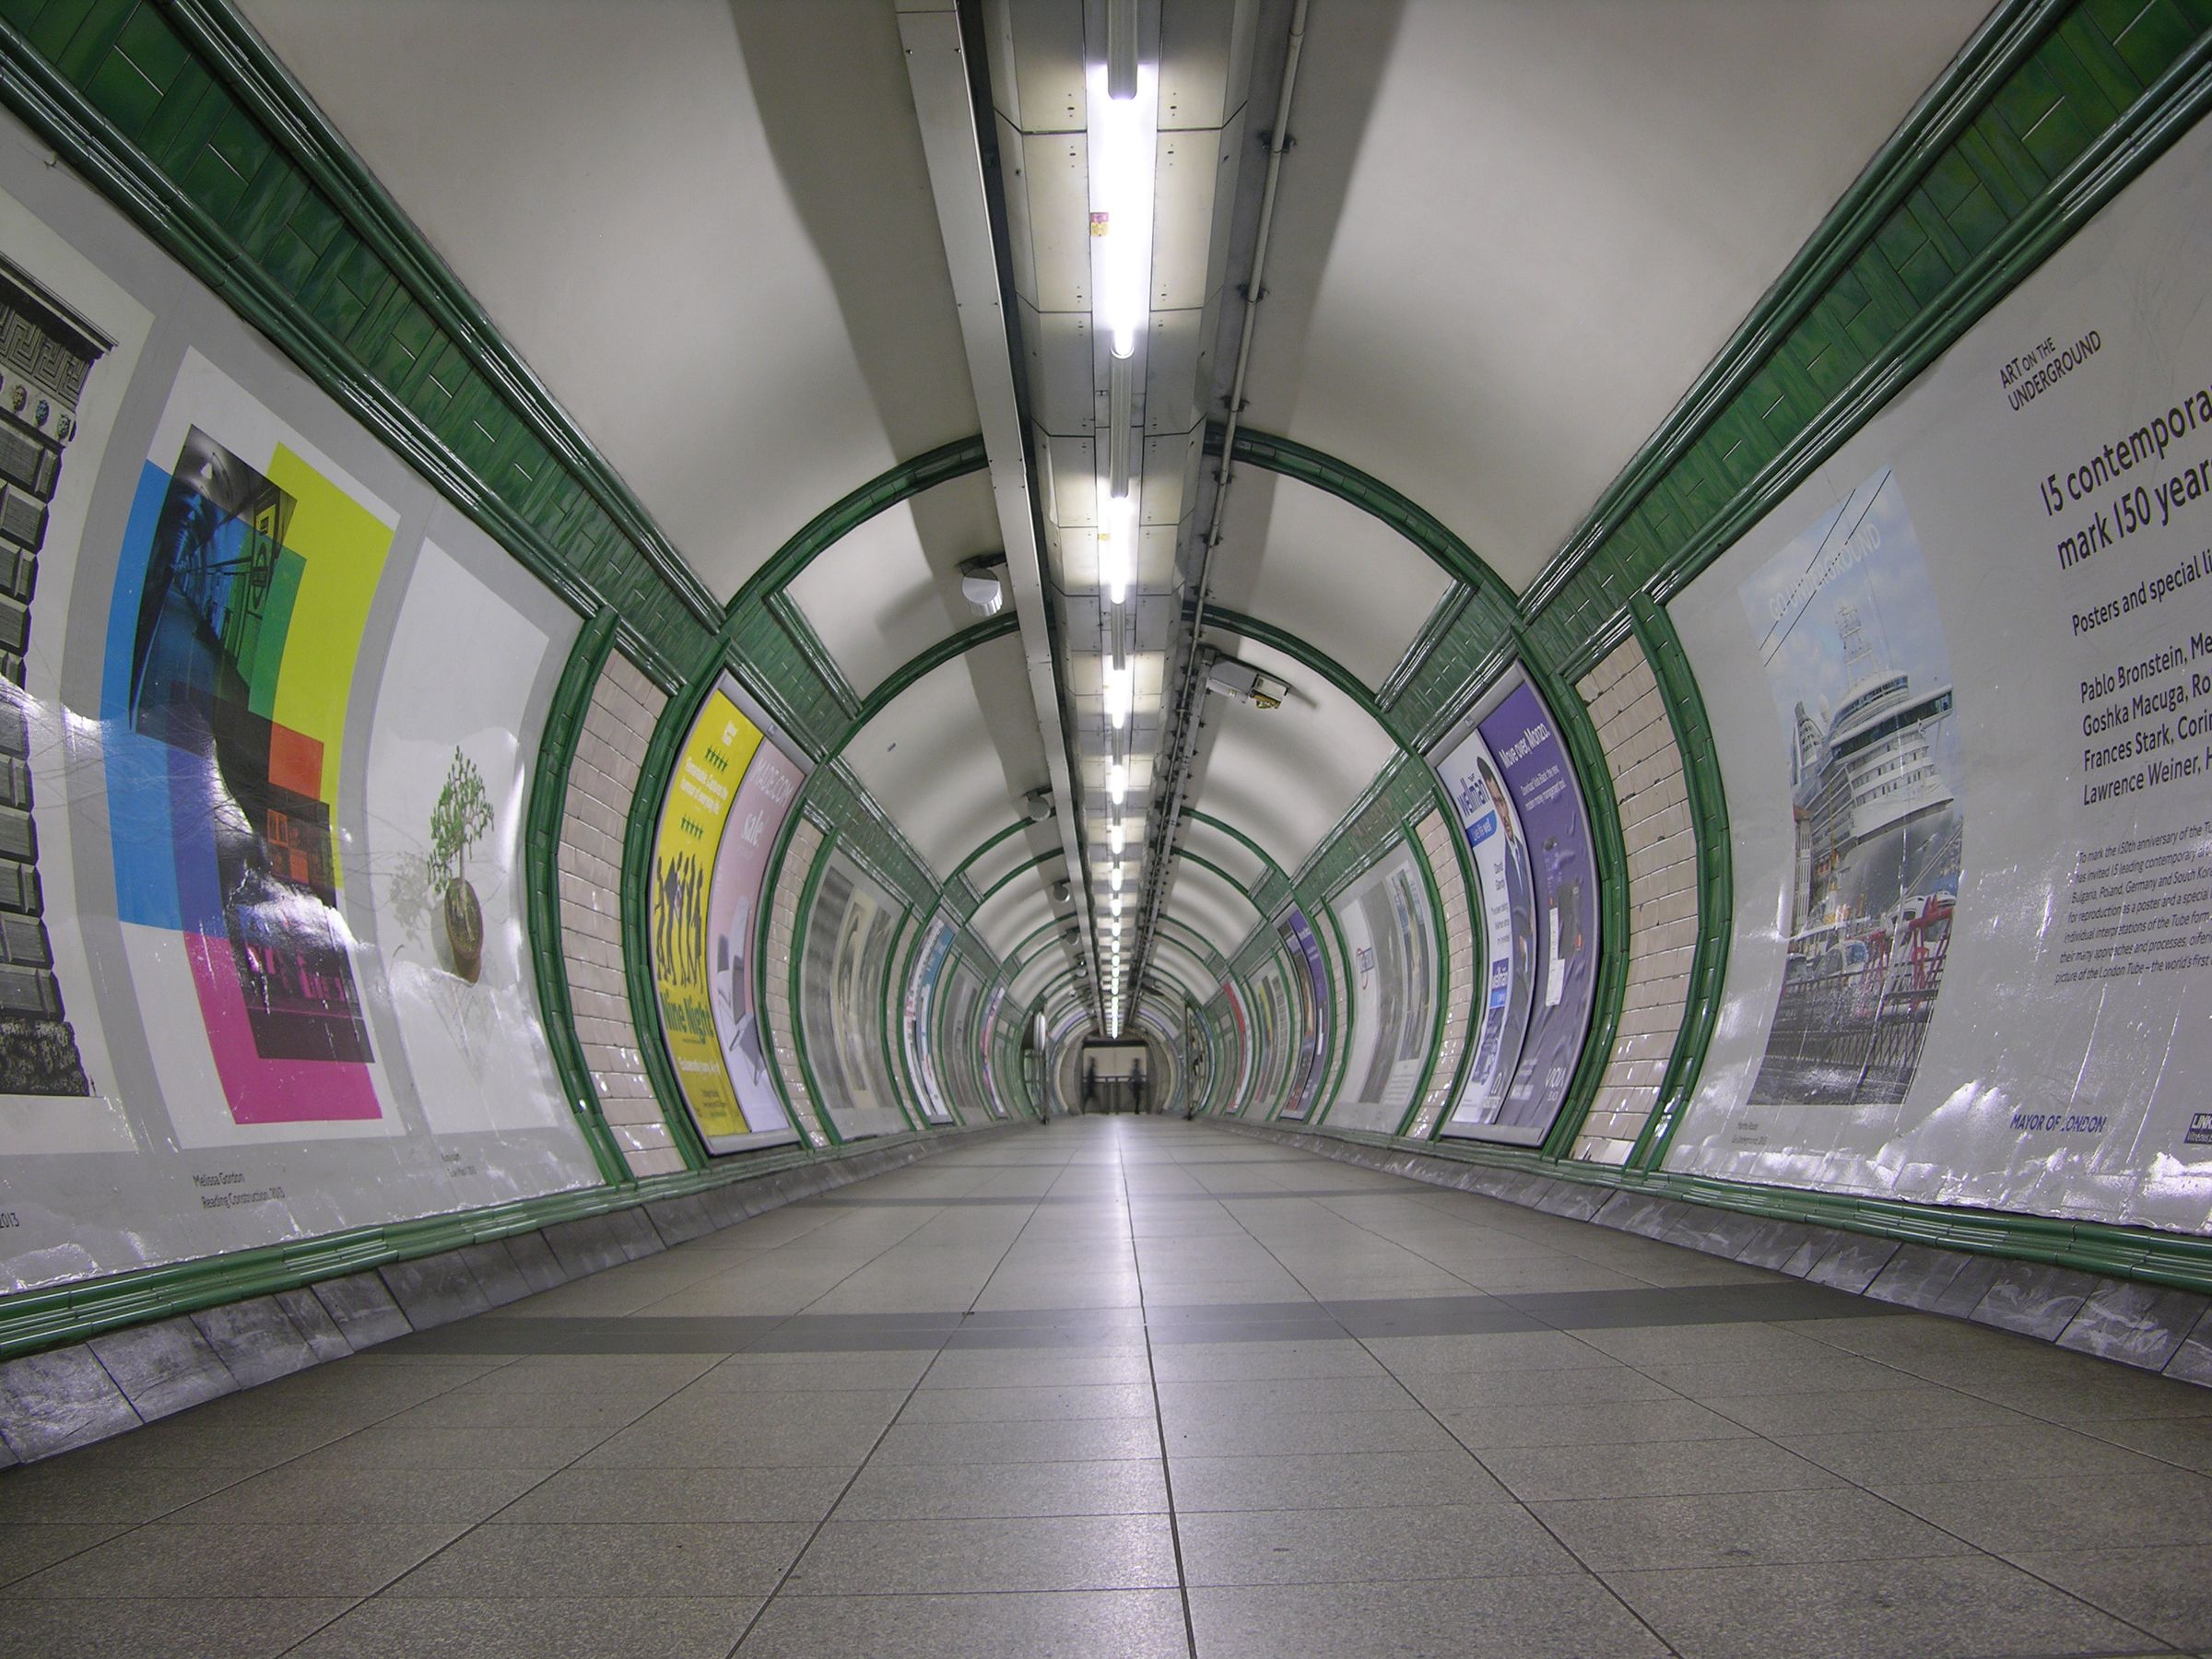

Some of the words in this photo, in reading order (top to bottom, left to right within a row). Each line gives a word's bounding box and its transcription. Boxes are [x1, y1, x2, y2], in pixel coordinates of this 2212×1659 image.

[1999, 357, 2023, 389] ART
[2022, 351, 2038, 371] ON
[2036, 336, 2056, 360] THE
[2007, 330, 2102, 412] UNDERGROUND
[2040, 474, 2065, 517] 15
[2066, 384, 2212, 502] contempora
[2057, 512, 2113, 571] mark
[2112, 486, 2151, 539] 150
[2154, 458, 2212, 527] year
[2072, 600, 2121, 636] Posters
[2123, 581, 2147, 614] and
[2148, 555, 2202, 603] special
[2080, 673, 2115, 704] Pablo
[2117, 645, 2188, 688] Bronstein,
[2083, 703, 2129, 737] Goshka
[2132, 684, 2189, 721] Macuga,
[2084, 740, 2132, 771] Frances
[2136, 722, 2175, 756] Stark,
[2083, 771, 2144, 806] Lawrence
[2147, 753, 2201, 788] Weiner,
[2104, 844, 2117, 858] the
[2136, 831, 2178, 851] anniversary
[2179, 826, 2190, 841] of
[2189, 824, 2203, 839] the
[2119, 860, 2144, 875] leading
[2145, 849, 2196, 869] contemporary
[2078, 905, 2122, 923] reproduction
[2136, 898, 2161, 914] poster
[2161, 892, 2177, 908] and
[2183, 887, 2210, 906] special
[2125, 877, 2158, 895] Germany
[2158, 871, 2173, 888] and
[2173, 870, 2196, 885] South
[2157, 917, 2171, 930] the
[2171, 913, 2190, 927] Tube
[2099, 964, 2125, 979] London
[2126, 961, 2144, 976] Tube
[2010, 1113, 2044, 1131] MAYOR
[2045, 1113, 2061, 1132] OF
